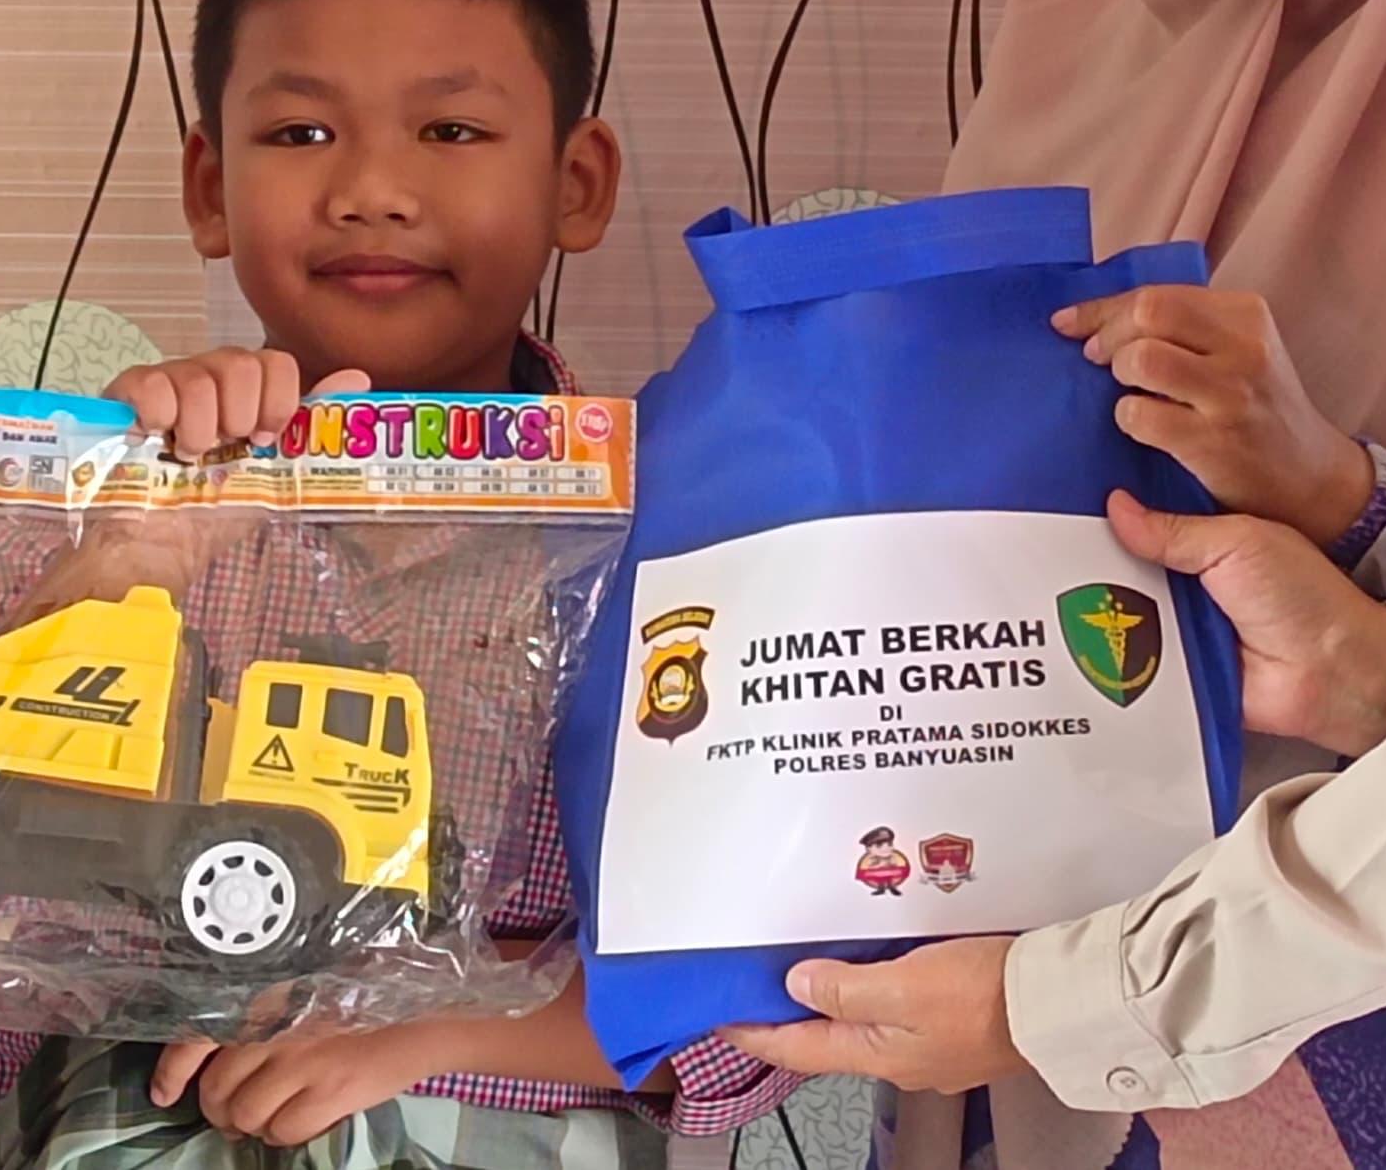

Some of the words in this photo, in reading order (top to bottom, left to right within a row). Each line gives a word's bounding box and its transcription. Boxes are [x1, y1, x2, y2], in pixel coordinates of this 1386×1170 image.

[740, 629, 866, 668] JUMAT
[880, 620, 1046, 654] BERKAH
[740, 667, 885, 706] KHITAN
[899, 659, 1046, 693] GRATIS
[879, 705, 903, 722] DI
[706, 738, 755, 761] FKTP
[762, 729, 842, 753] KLINIK
[851, 727, 963, 747] PRATAMA
[970, 718, 1091, 740] SIDOKKES
[773, 751, 867, 774] POLRES
[875, 744, 1014, 769] BANYUASIN
